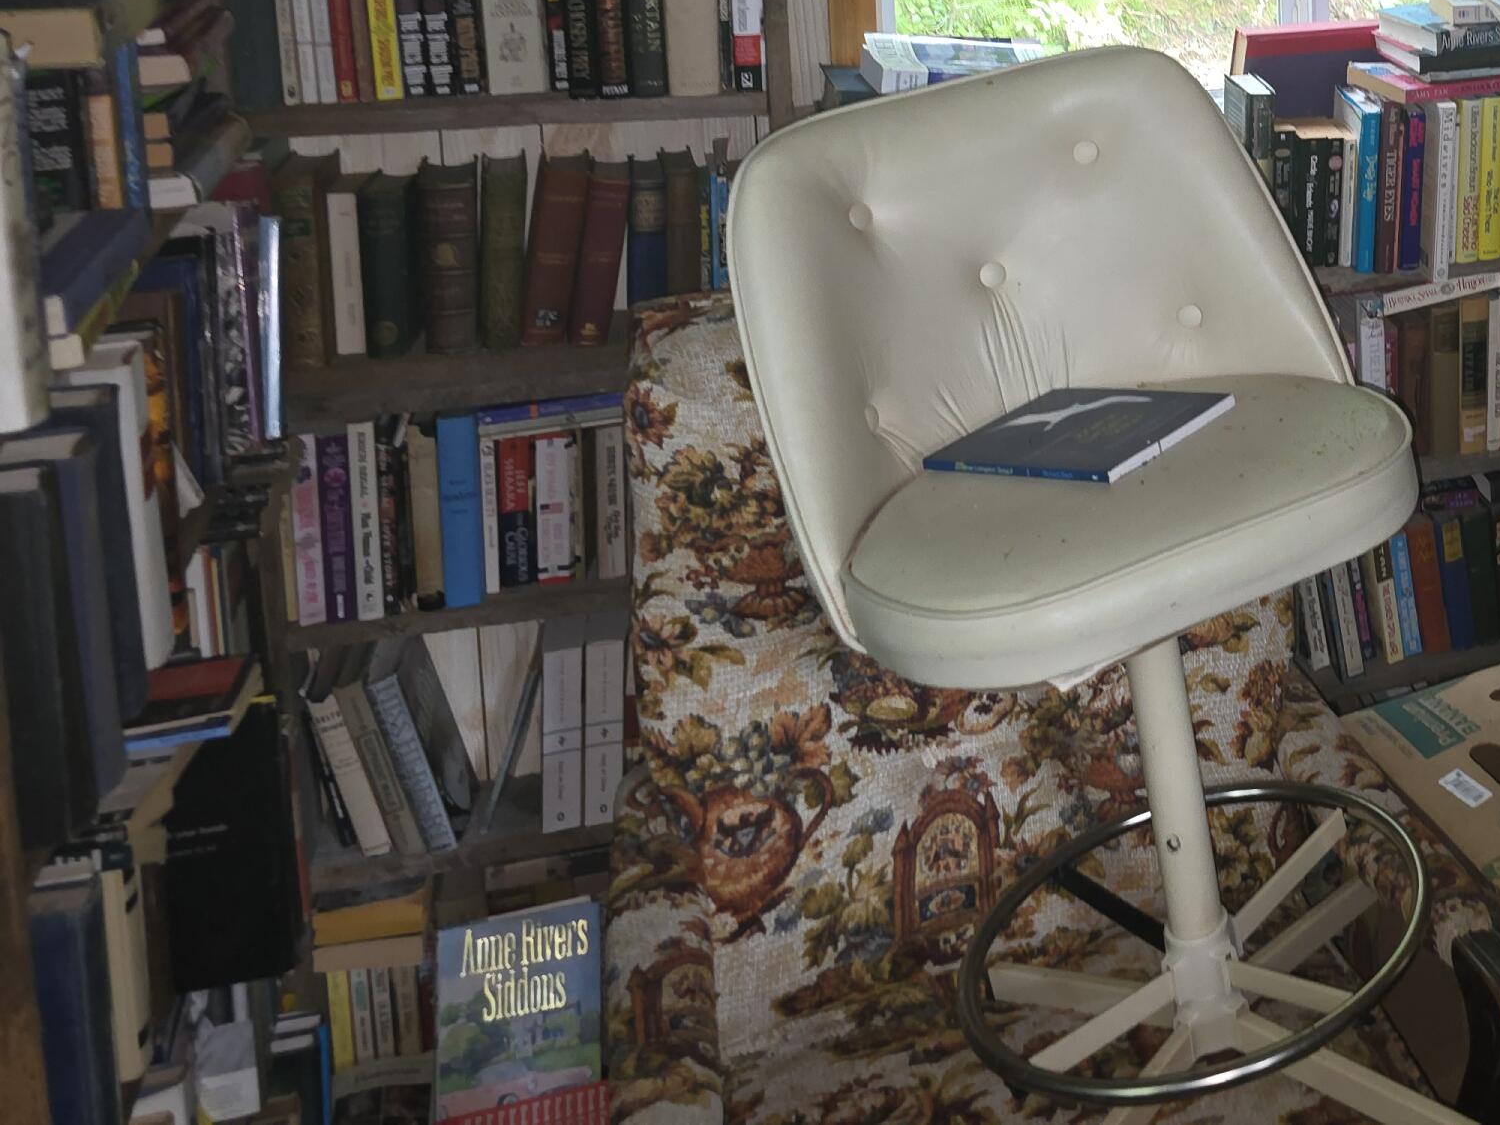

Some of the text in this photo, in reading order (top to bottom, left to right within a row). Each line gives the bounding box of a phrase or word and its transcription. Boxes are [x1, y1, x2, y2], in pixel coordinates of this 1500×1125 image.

[1466, 28, 1494, 45] Rivers
[1440, 111, 1454, 189] Midwives
[1468, 130, 1479, 165] Jackson
[1383, 151, 1397, 223] TIGER EYES
[1468, 165, 1478, 193] Braun
[503, 458, 517, 512] SHAARA
[516, 526, 530, 583] GLORIOUS
[460, 917, 590, 978] Anne Rivers
[481, 965, 569, 1024] Siddons
